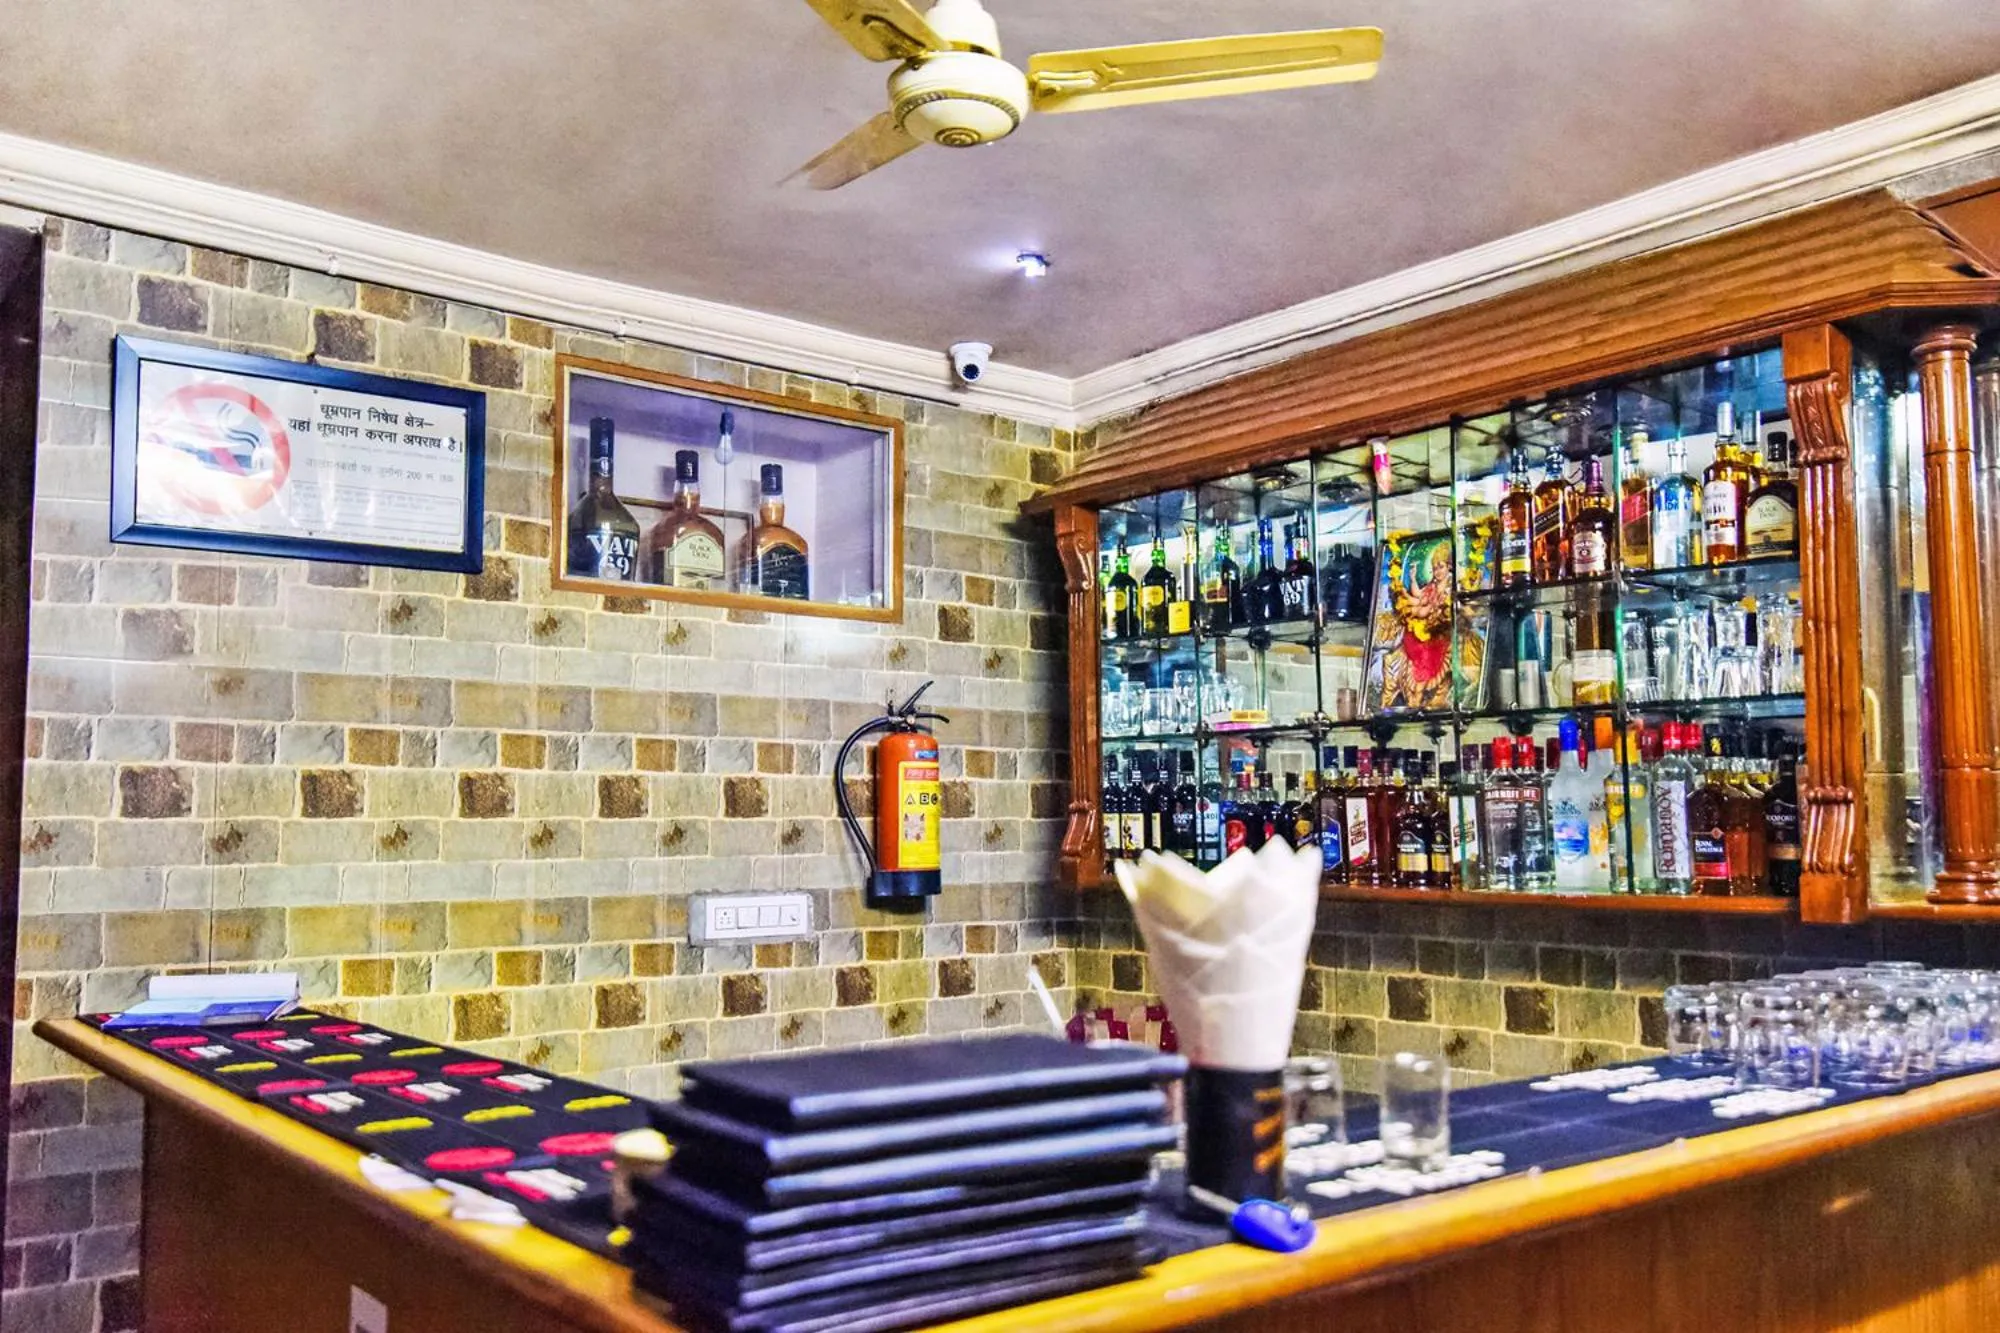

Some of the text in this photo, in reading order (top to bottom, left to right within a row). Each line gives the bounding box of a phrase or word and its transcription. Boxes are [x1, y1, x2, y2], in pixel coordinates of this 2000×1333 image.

[320, 404, 360, 420] धूम्रपान
[368, 407, 398, 425] निषेध
[288, 417, 310, 432] यहां
[317, 422, 358, 438] धूम्रपान
[365, 428, 398, 444] करना
[403, 434, 442, 449] अपराध
